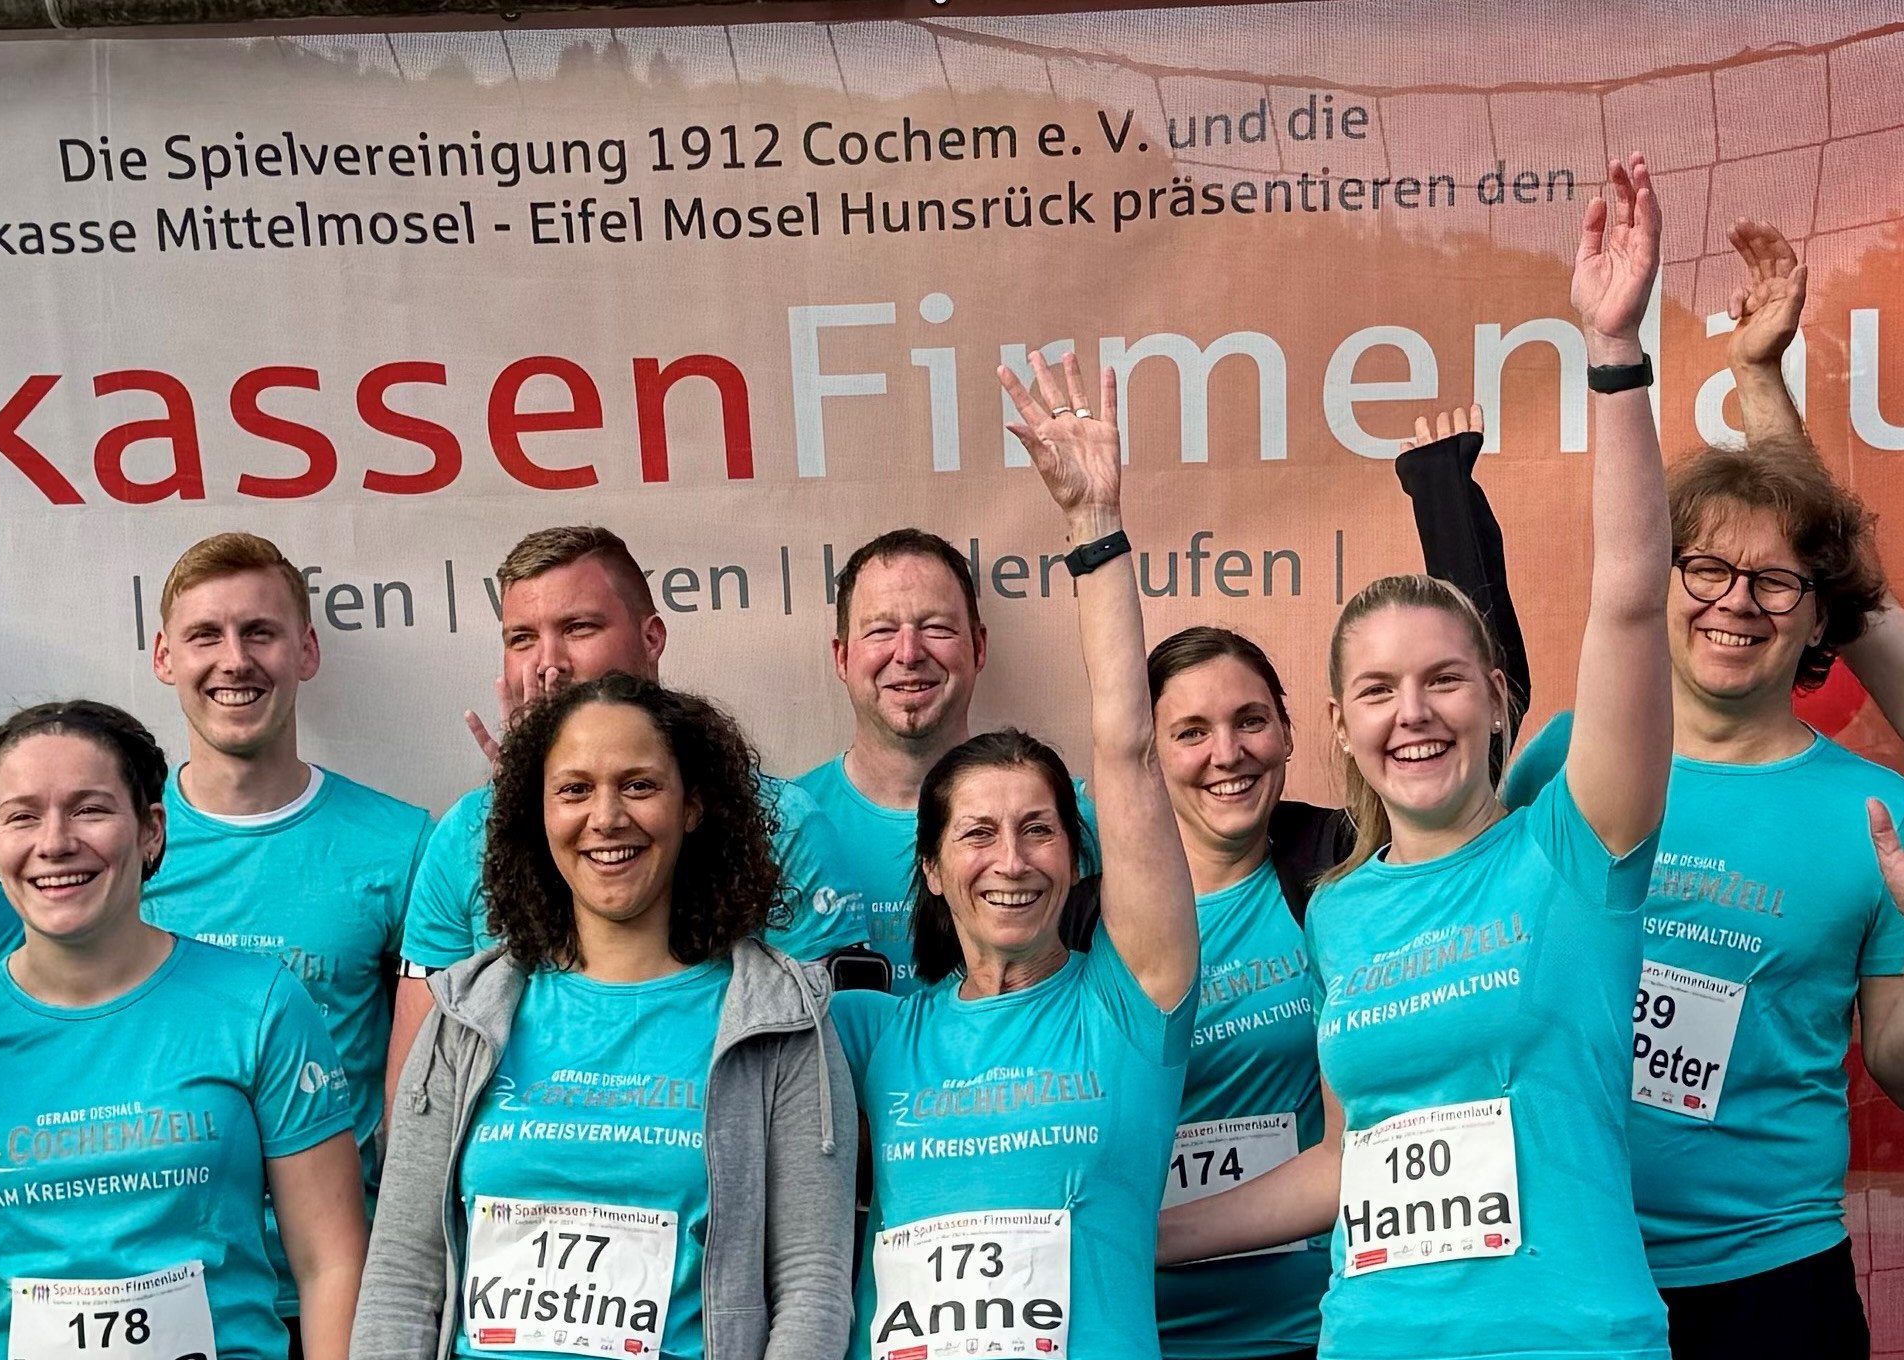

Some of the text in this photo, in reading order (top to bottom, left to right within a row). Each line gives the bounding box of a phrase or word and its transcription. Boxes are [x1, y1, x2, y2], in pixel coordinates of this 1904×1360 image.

[59, 93, 1370, 190] Die Spielvereinigung 1912 Cochem e. V. und die
[156, 201, 476, 253] Mittelmosel
[530, 196, 643, 245] Eifel
[664, 191, 821, 242] Mosel
[842, 180, 1096, 236] Hunsrück
[1113, 166, 1456, 233] präsentieren
[1477, 160, 1575, 207] den
[1643, 917, 1762, 953] ISVERWALTUNG
[1346, 968, 1521, 1031] KREISVERWALTUNG
[1633, 1032, 1720, 1091] Peter
[520, 1075, 703, 1110] COCHEMZEL
[913, 1069, 1106, 1120] COCHEMZELL
[7, 1108, 221, 1166] COCHEMZELL
[519, 1119, 704, 1149] KREISVERWALTUNG
[920, 1125, 1099, 1161] KREISVERWALTUNG
[1171, 1147, 1243, 1188] 174
[1384, 1138, 1452, 1185] 180
[24, 1165, 210, 1206] KREISVERWALTUNG
[1343, 1188, 1513, 1248] Hanna
[531, 1230, 611, 1273] 177
[927, 1241, 1005, 1284] 173
[67, 1307, 152, 1350] 178
[468, 1275, 660, 1335] Kristina
[876, 1296, 1064, 1345] Anne
